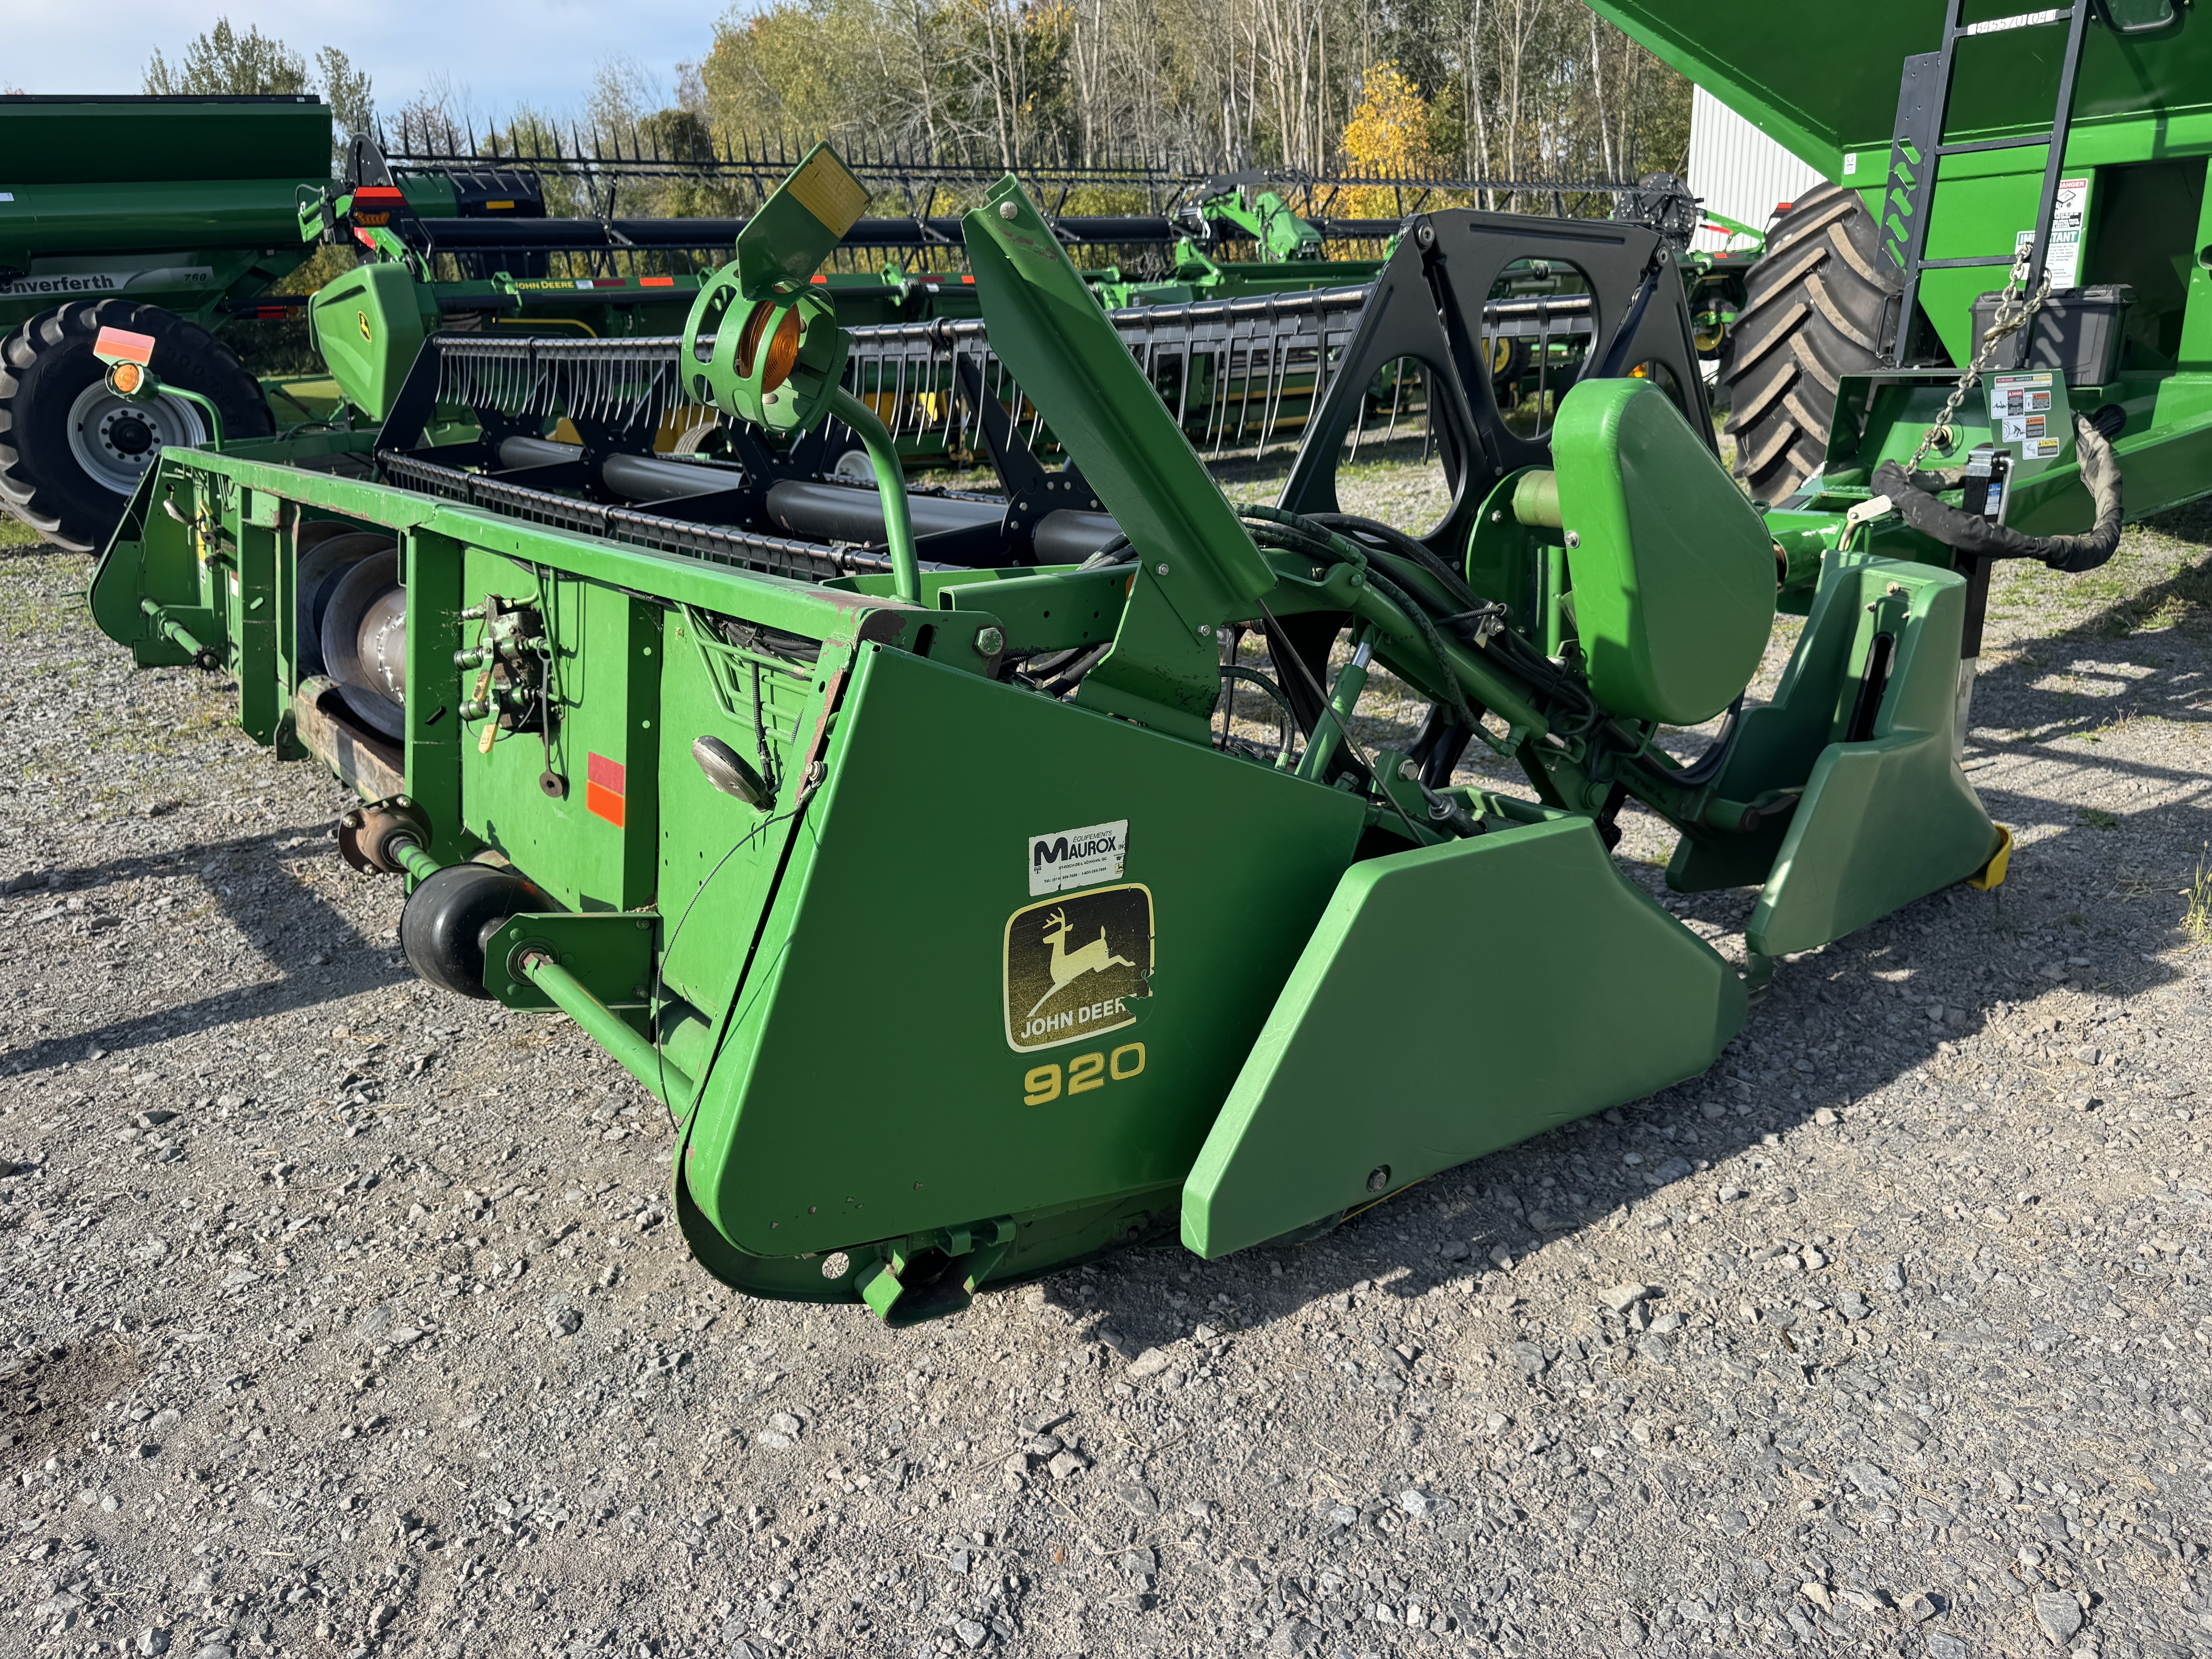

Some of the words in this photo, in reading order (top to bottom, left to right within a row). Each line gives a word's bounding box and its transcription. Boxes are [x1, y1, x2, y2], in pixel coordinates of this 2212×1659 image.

[2020, 231, 2077, 244] IMTANT
[184, 273, 207, 283] 760
[541, 281, 575, 289] DEERE
[1034, 836, 1116, 866] MAUROX
[1021, 1010, 1073, 1039] JOHN
[1079, 994, 1137, 1024] DEER
[1024, 1041, 1146, 1106] 920
